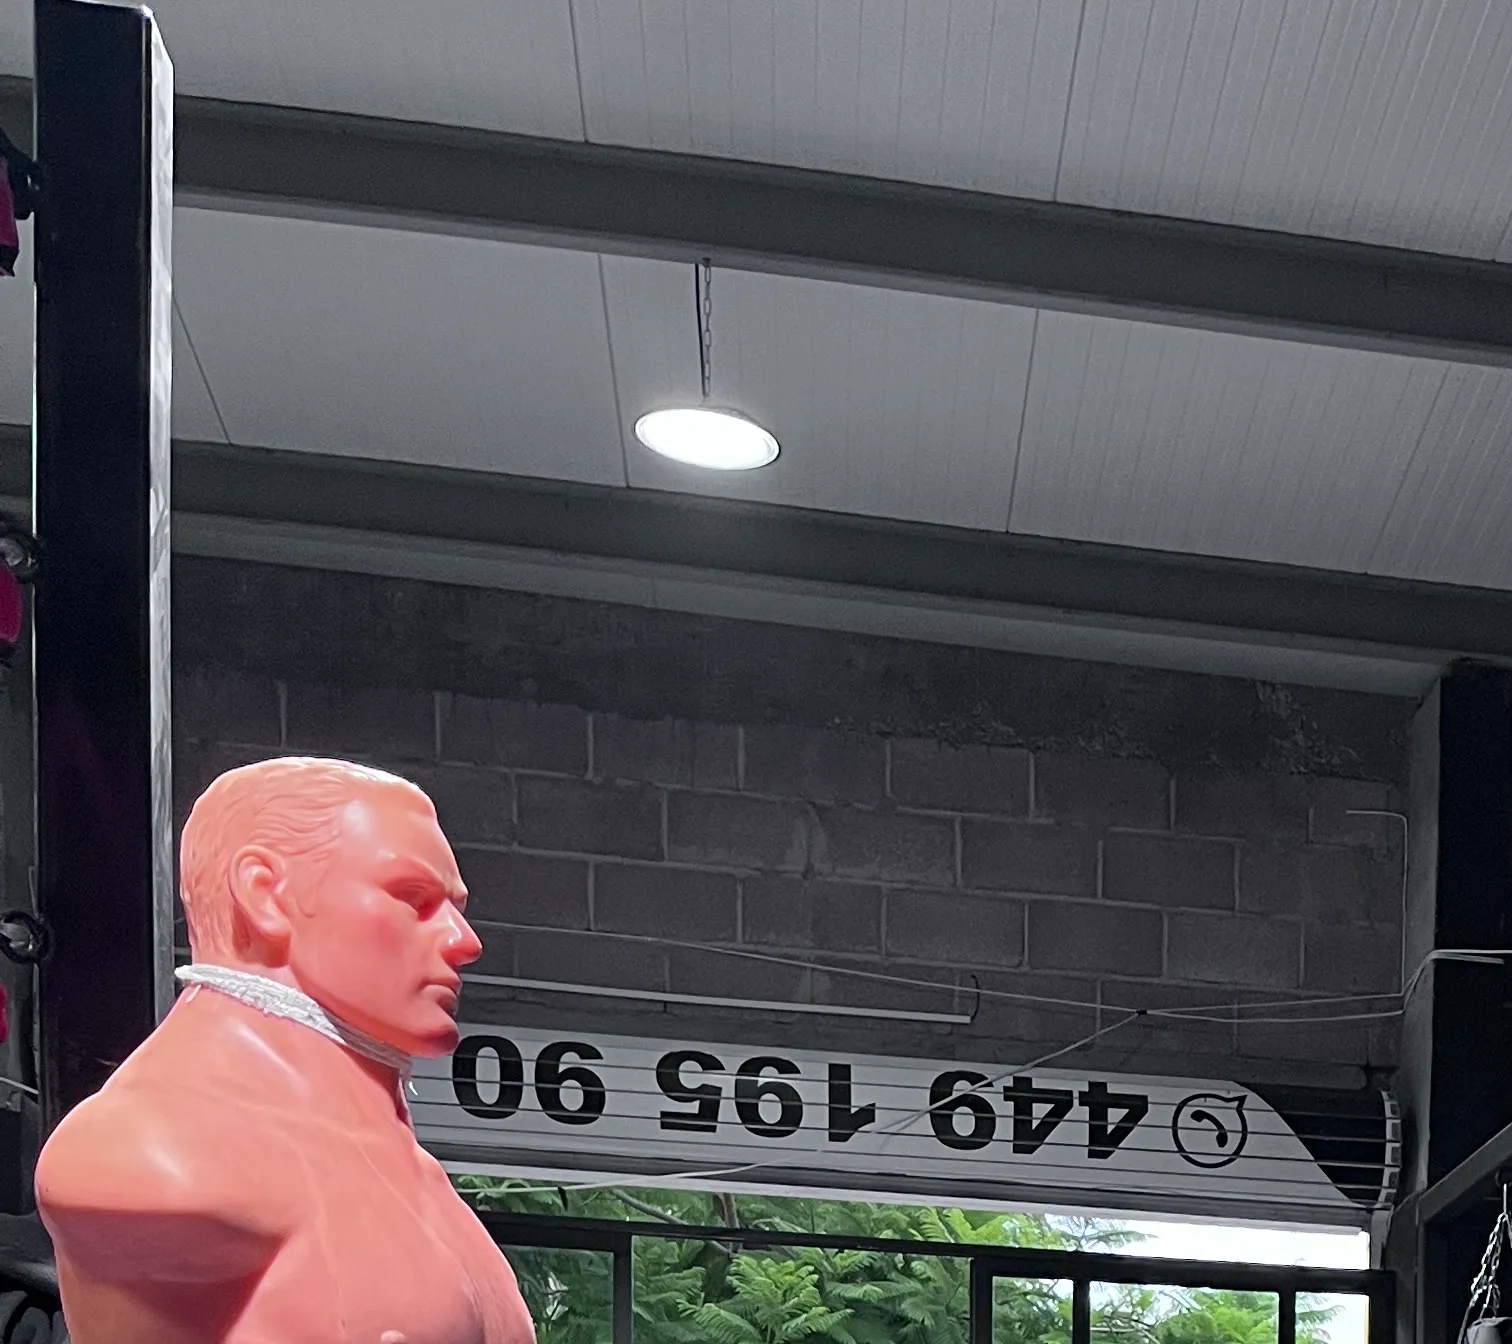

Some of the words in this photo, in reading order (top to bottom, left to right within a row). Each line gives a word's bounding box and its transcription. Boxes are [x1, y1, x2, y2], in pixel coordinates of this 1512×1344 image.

[451, 1034, 606, 1126] 90
[655, 1050, 877, 1143] 195
[928, 1070, 1149, 1161] 449
